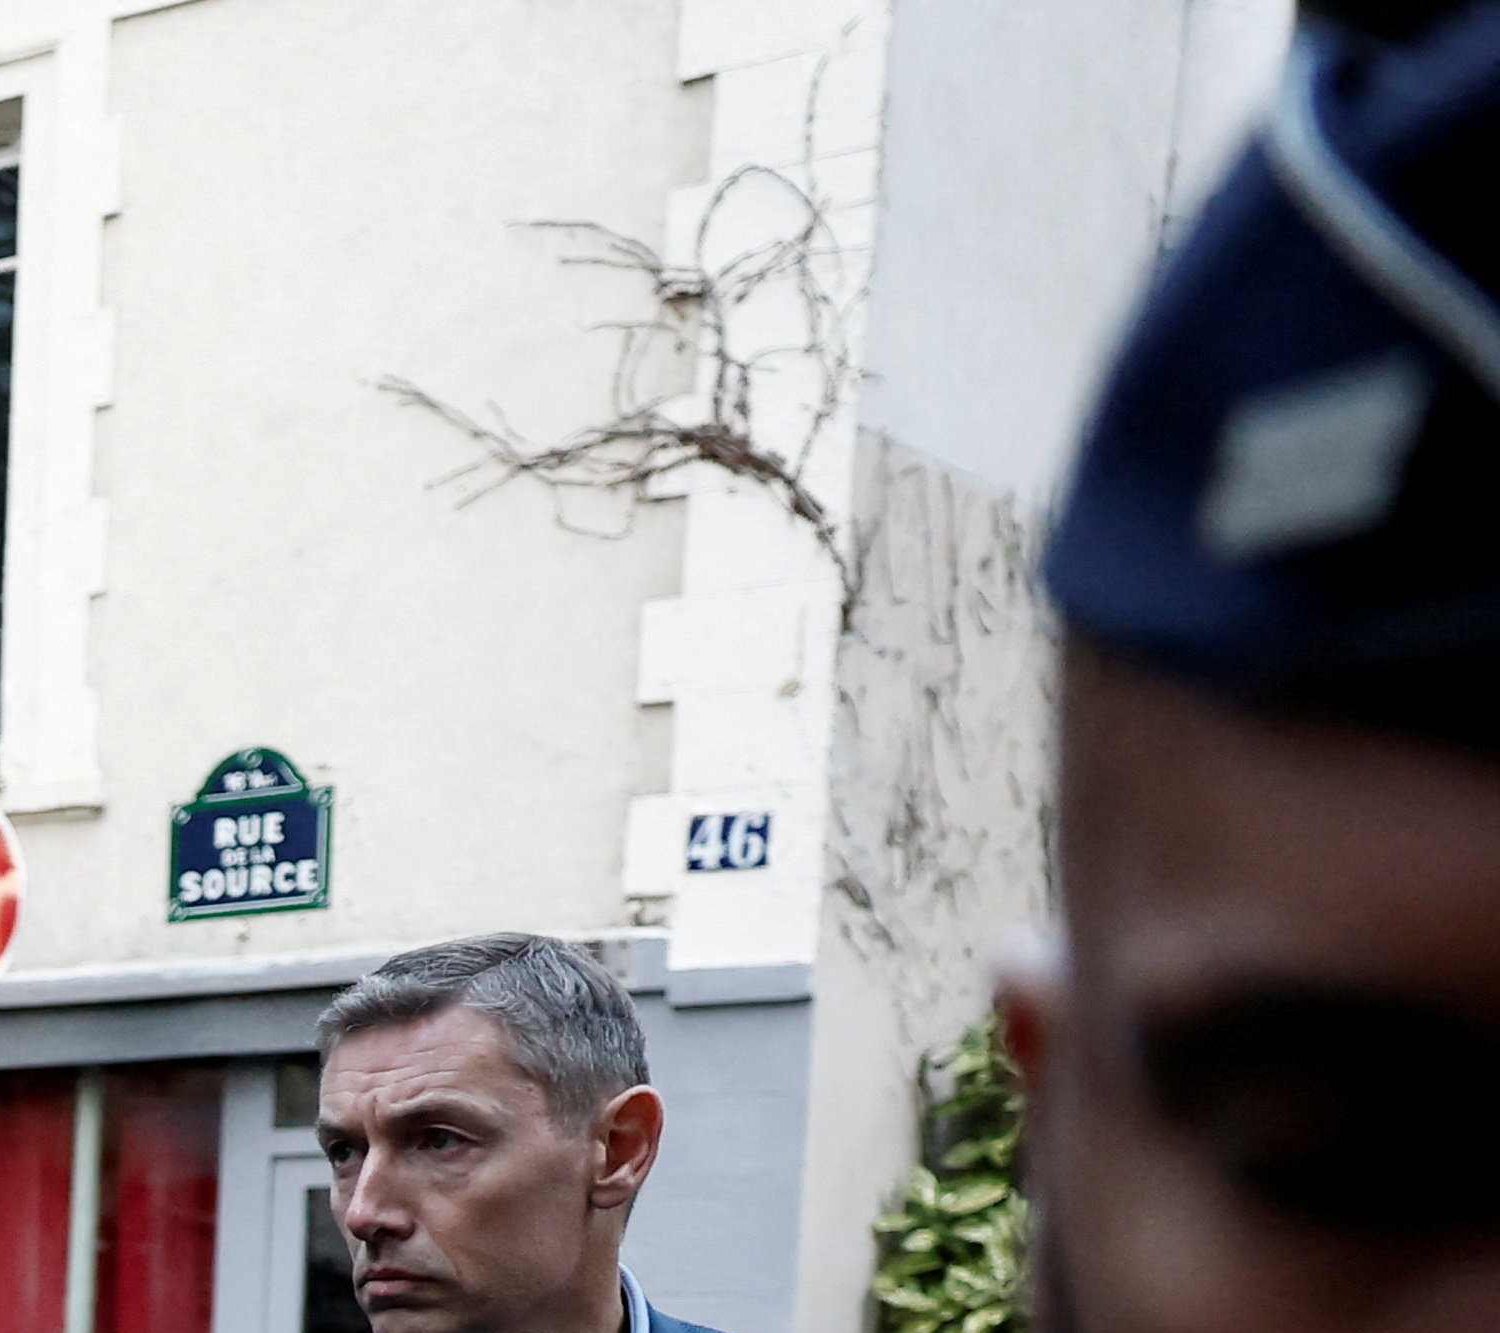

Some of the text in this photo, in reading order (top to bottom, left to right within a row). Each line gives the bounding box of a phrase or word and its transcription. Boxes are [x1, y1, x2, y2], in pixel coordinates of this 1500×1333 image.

[213, 811, 285, 849] RUE
[688, 812, 765, 869] 46
[179, 859, 319, 902] SOURCE
